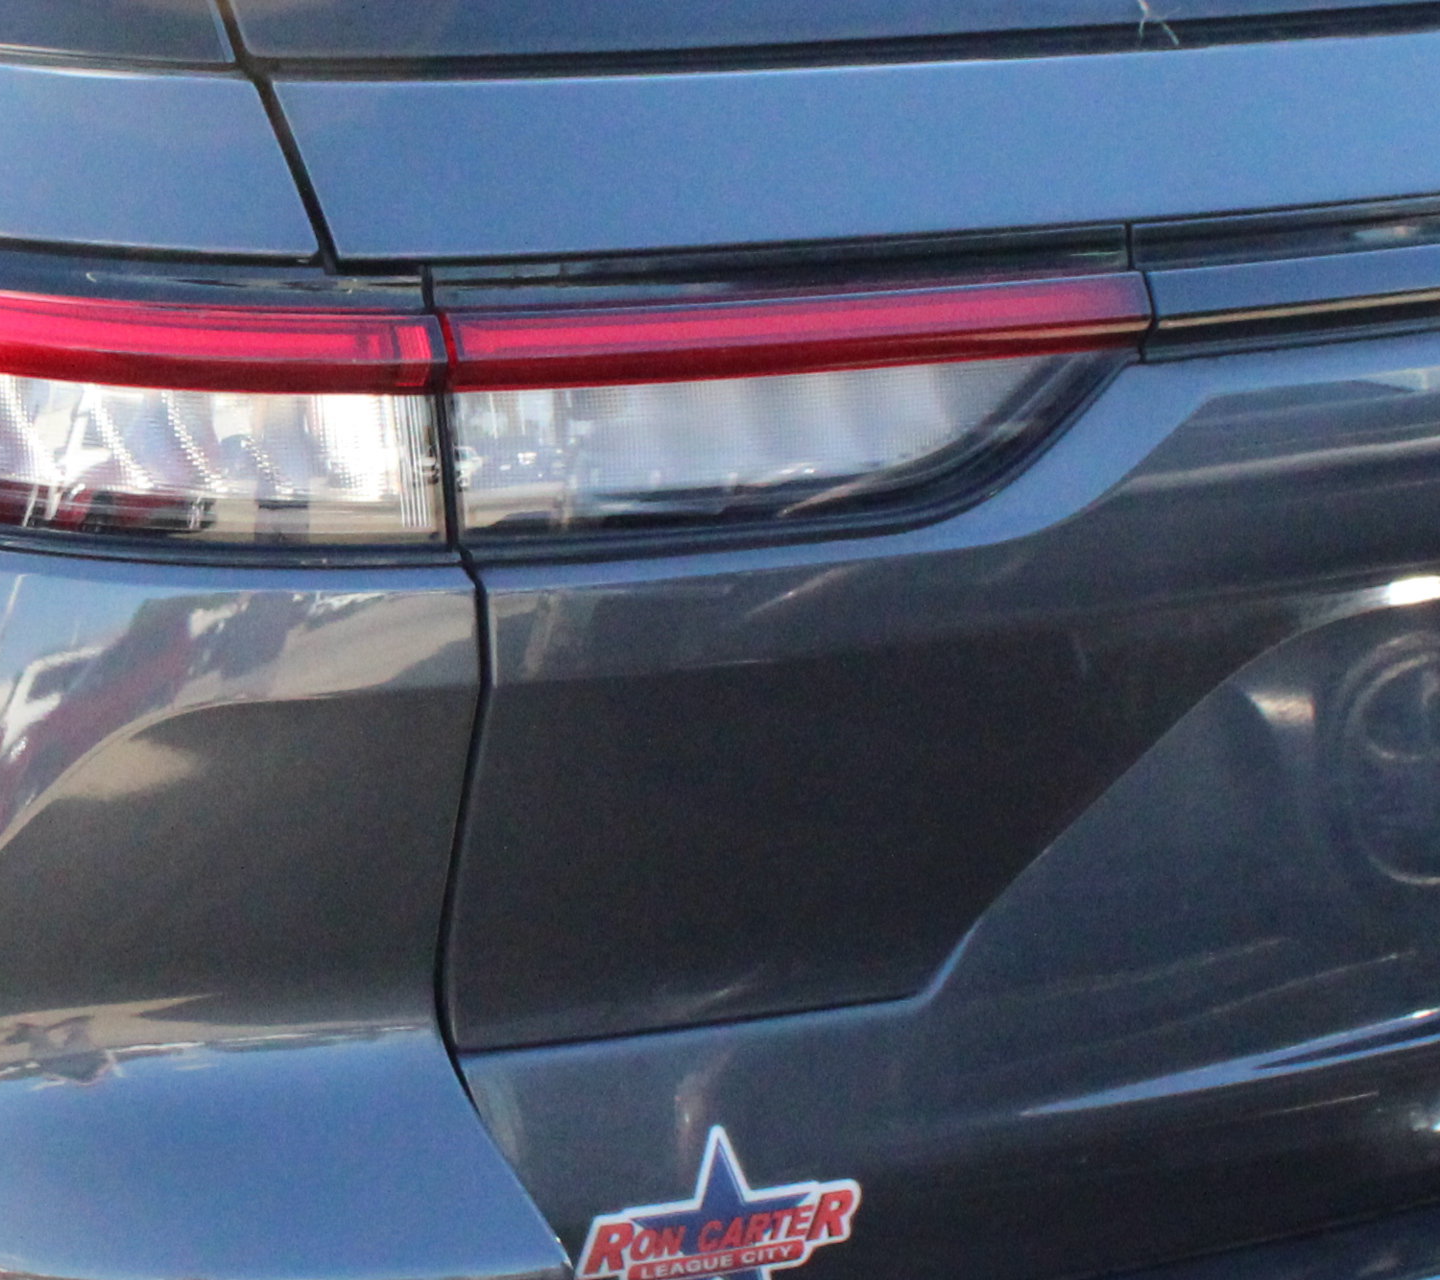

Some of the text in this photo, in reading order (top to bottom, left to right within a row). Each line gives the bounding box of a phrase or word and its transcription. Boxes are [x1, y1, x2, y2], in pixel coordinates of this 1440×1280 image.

[582, 1188, 855, 1275] RON CARTER
[640, 1244, 794, 1280] LEAGUE CITY
